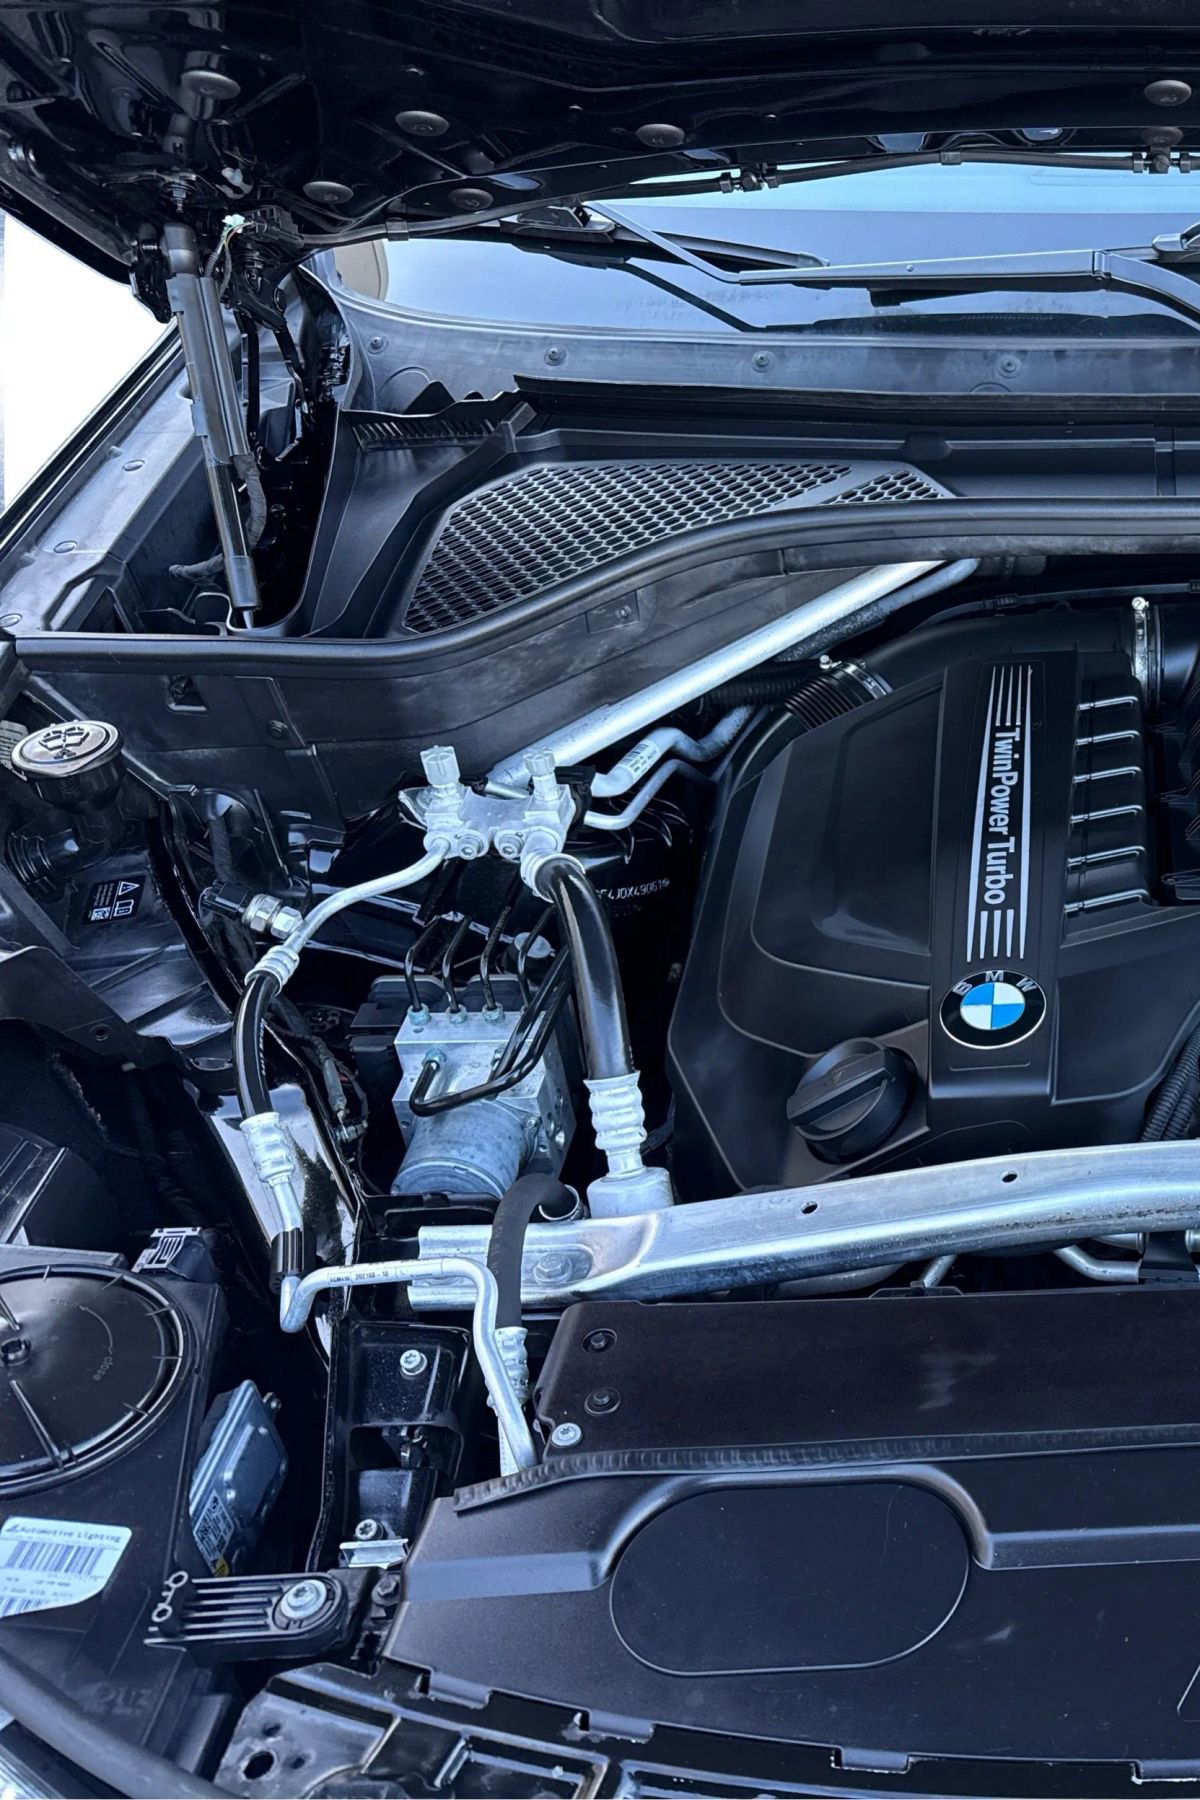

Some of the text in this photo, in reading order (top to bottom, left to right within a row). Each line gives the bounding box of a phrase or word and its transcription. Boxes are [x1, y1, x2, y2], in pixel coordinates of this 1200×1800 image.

[984, 727, 1021, 905] TwinPower Turbo
[952, 970, 1038, 996] BMW
[20, 1526, 122, 1543] Automotive Lighting
